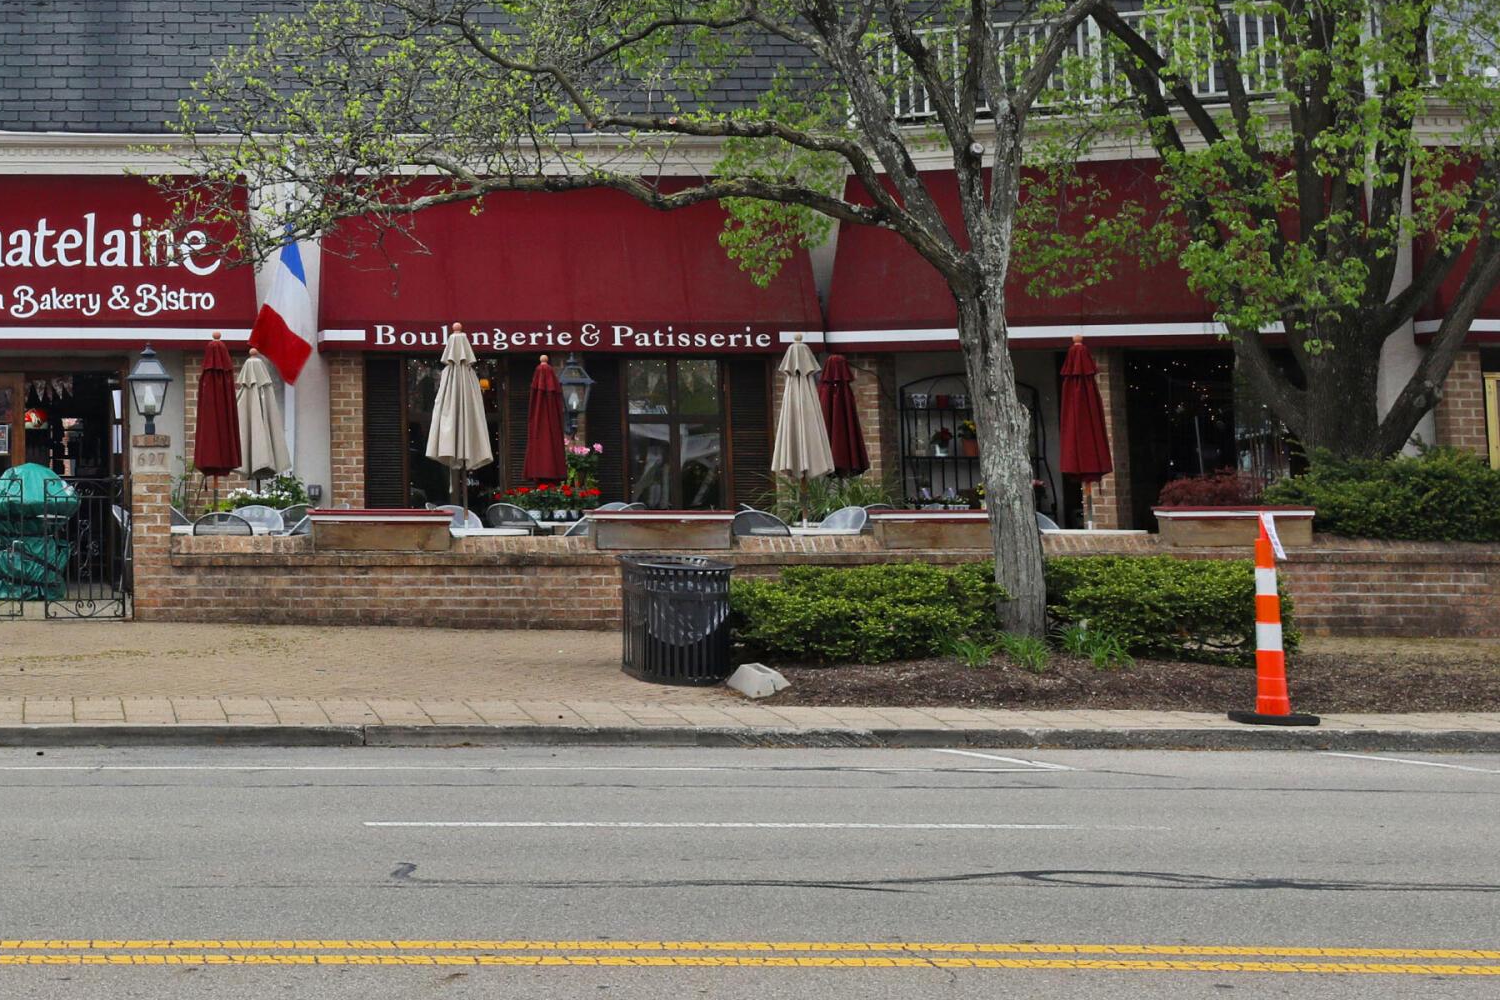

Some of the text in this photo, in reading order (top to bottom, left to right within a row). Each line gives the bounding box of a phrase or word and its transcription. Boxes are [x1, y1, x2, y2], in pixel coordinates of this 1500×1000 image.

[10, 285, 100, 318] Bakery
[107, 285, 130, 311] &
[133, 283, 215, 316] Bistro
[373, 323, 771, 350] Boulngerie & Patisserie
[138, 453, 165, 466] 627
